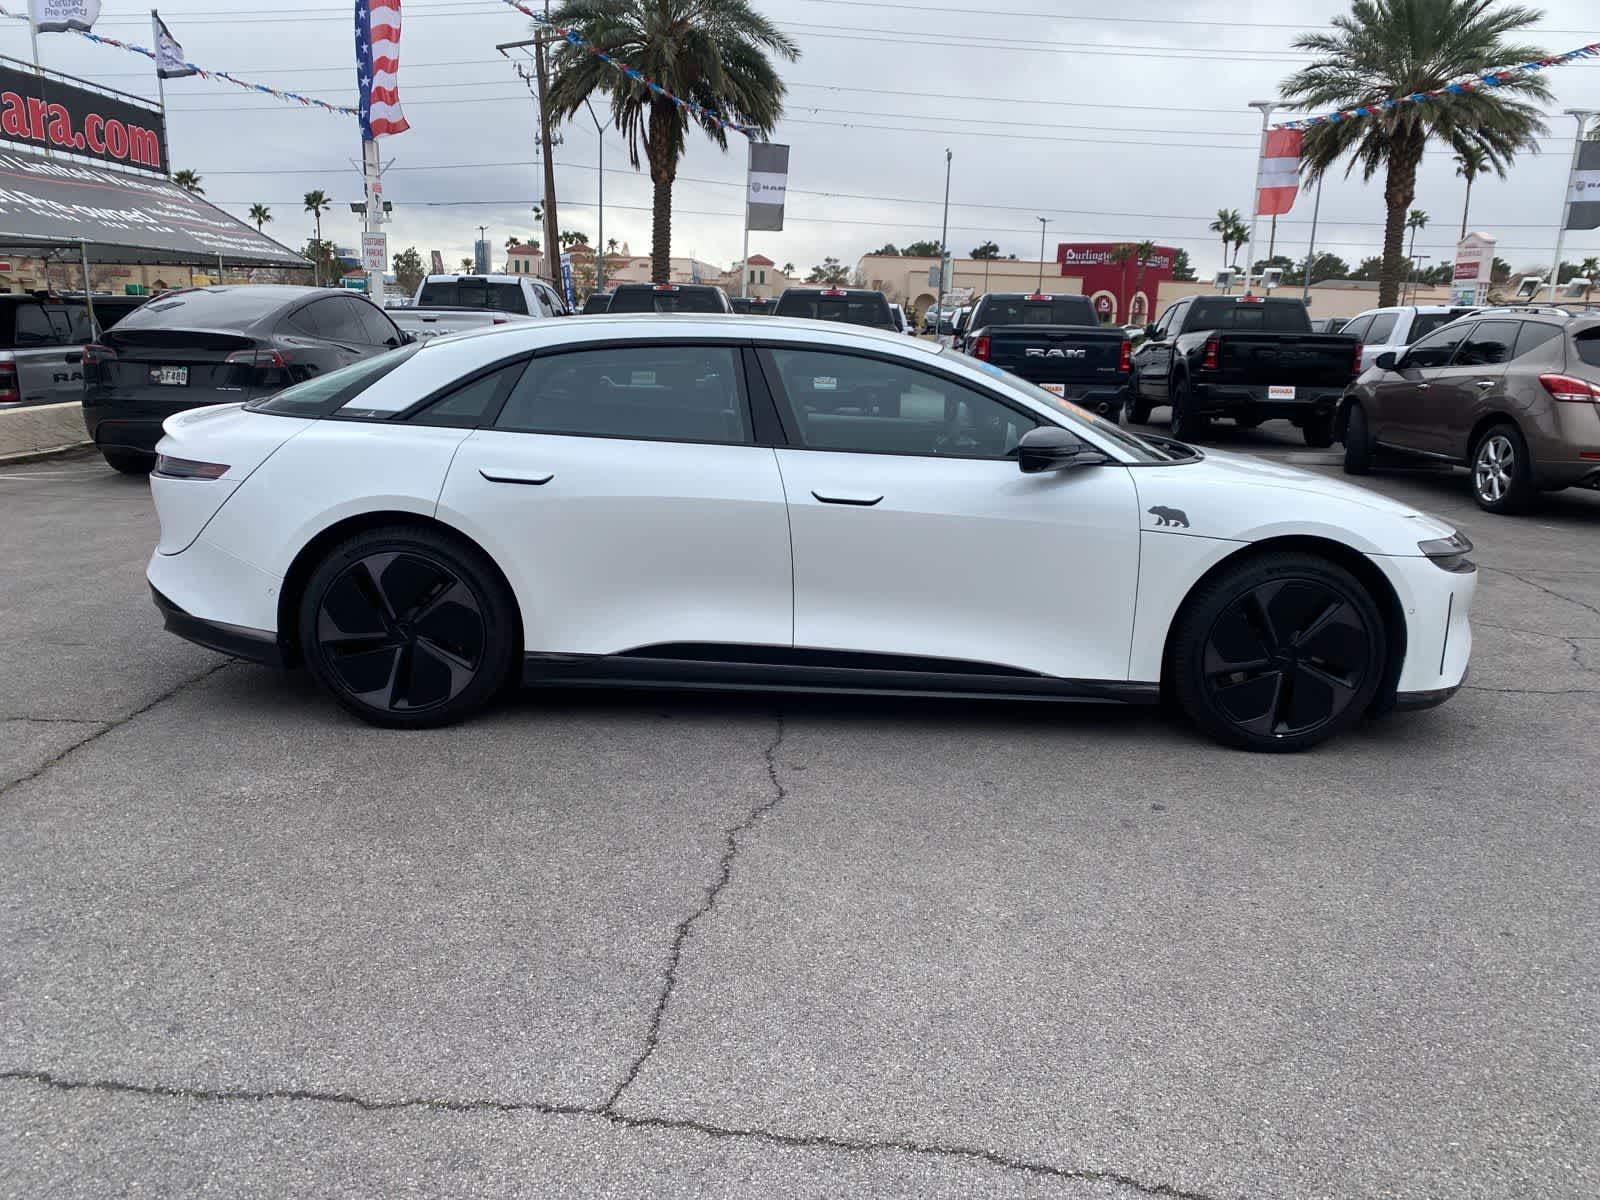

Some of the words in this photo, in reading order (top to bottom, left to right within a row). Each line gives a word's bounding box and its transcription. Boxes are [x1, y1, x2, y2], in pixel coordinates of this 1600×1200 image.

[0, 91, 161, 168] ara.com
[1066, 249, 1113, 260] Burlingto
[1025, 348, 1087, 358] RAM
